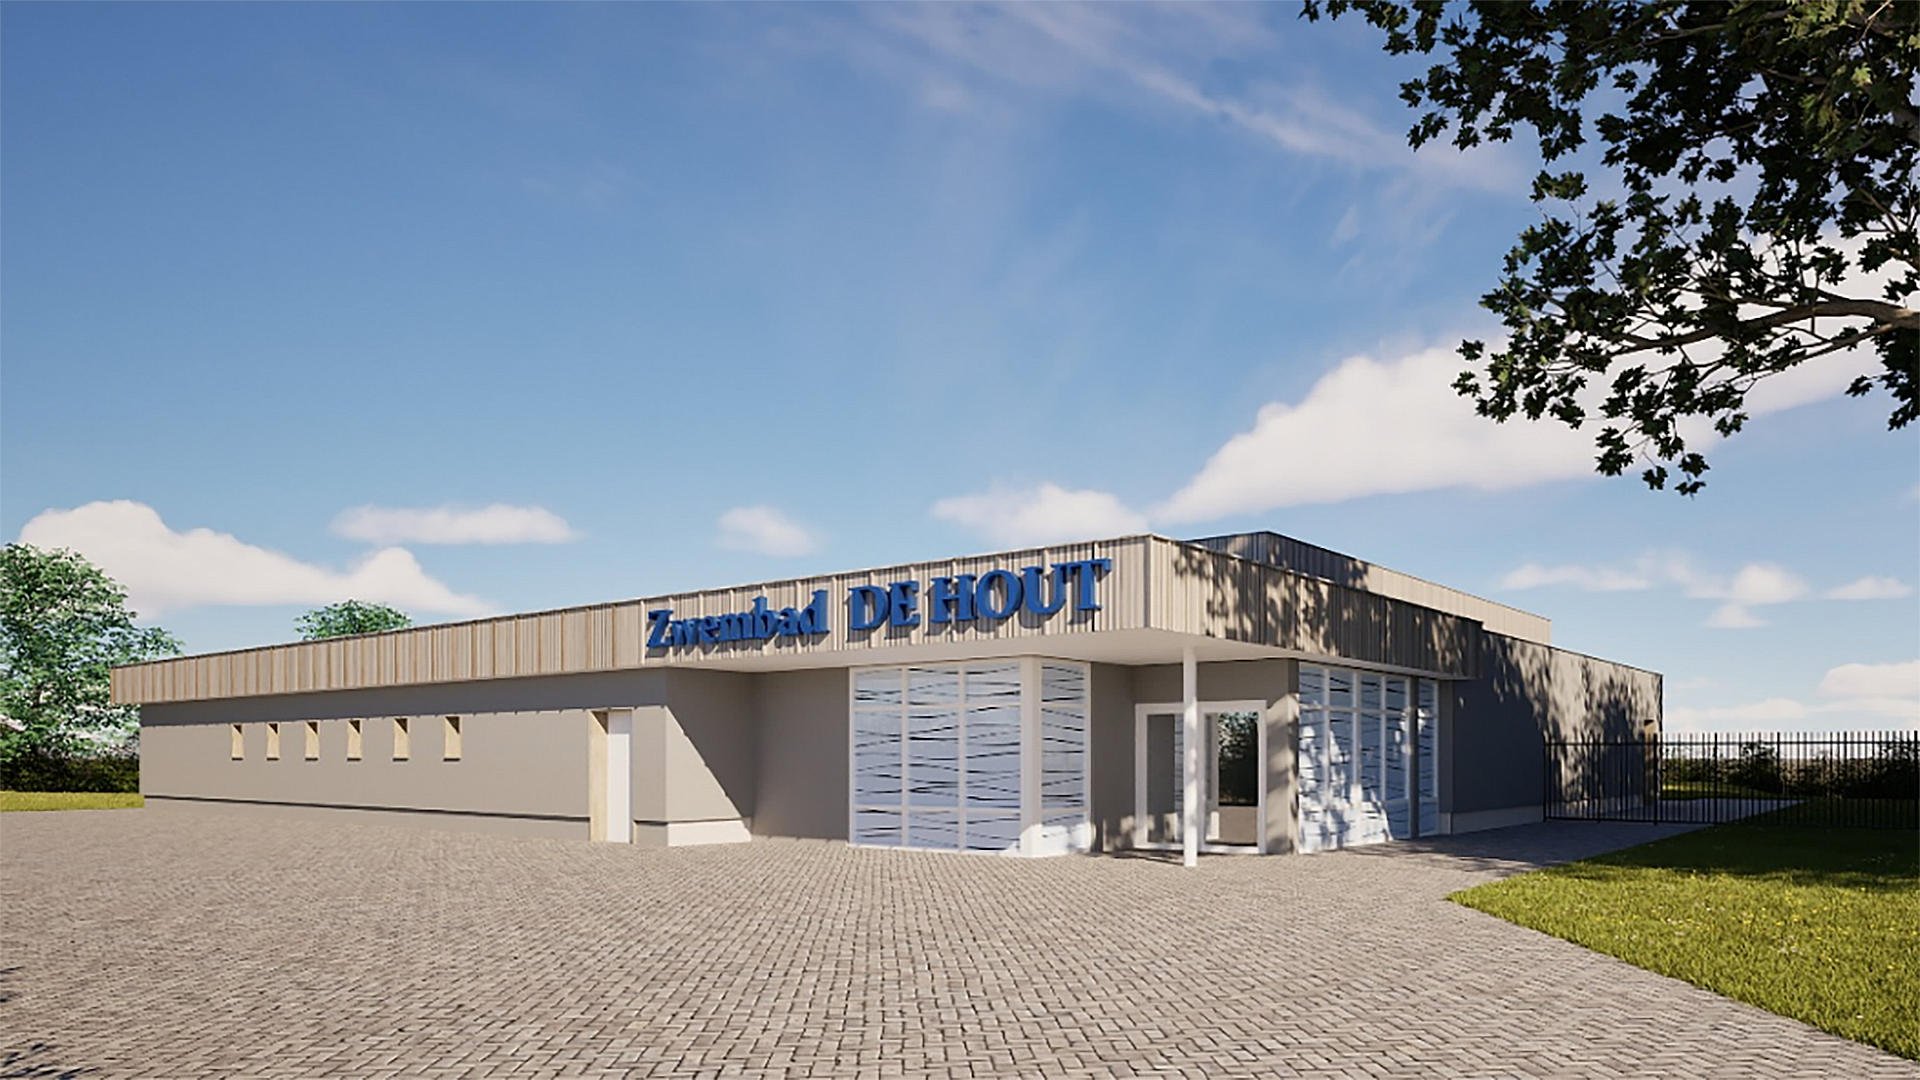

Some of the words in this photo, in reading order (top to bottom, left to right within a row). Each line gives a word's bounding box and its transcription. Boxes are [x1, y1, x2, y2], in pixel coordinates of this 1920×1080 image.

[646, 589, 829, 648] Zwembad
[847, 580, 920, 630] DE
[930, 558, 1112, 623] HOUT
